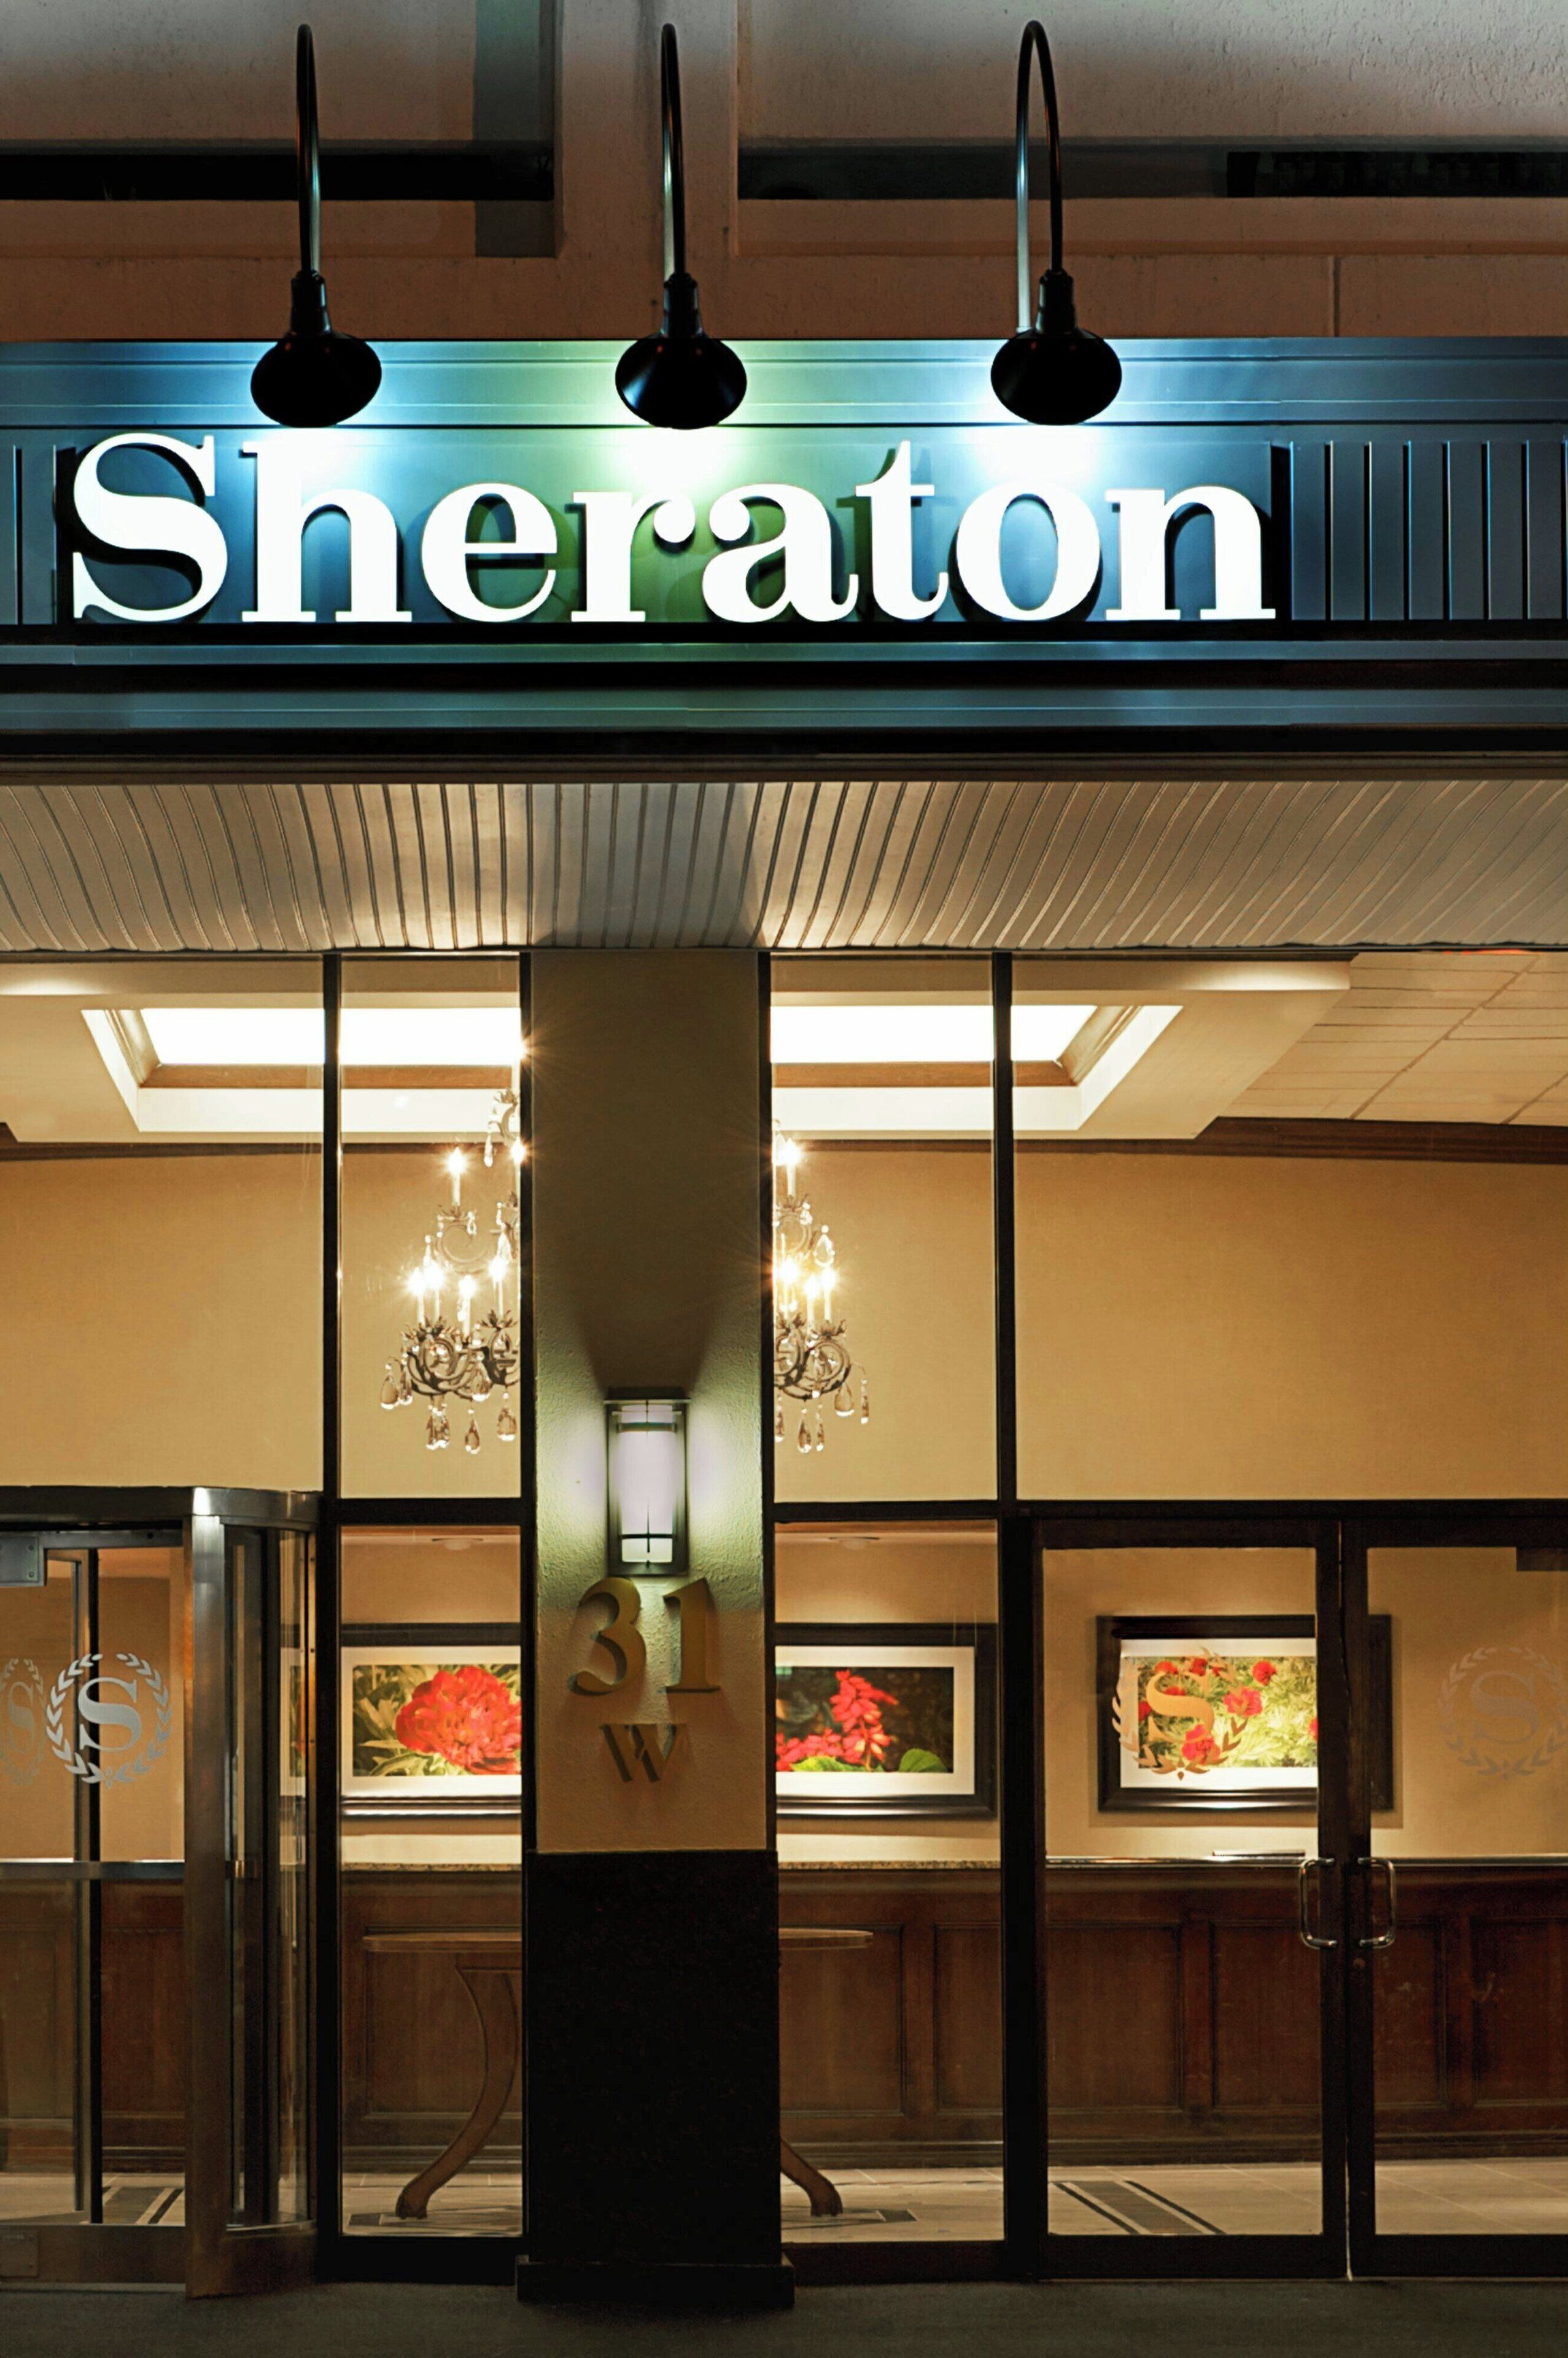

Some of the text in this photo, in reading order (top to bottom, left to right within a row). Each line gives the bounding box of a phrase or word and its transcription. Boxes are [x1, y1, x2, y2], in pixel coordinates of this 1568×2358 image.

[73, 433, 1276, 623] Sheraton
[569, 1577, 721, 1695] 31
[78, 1677, 141, 1752] S
[1146, 1670, 1215, 1743] S
[1470, 1670, 1539, 1745] S
[600, 1723, 688, 1783] W
